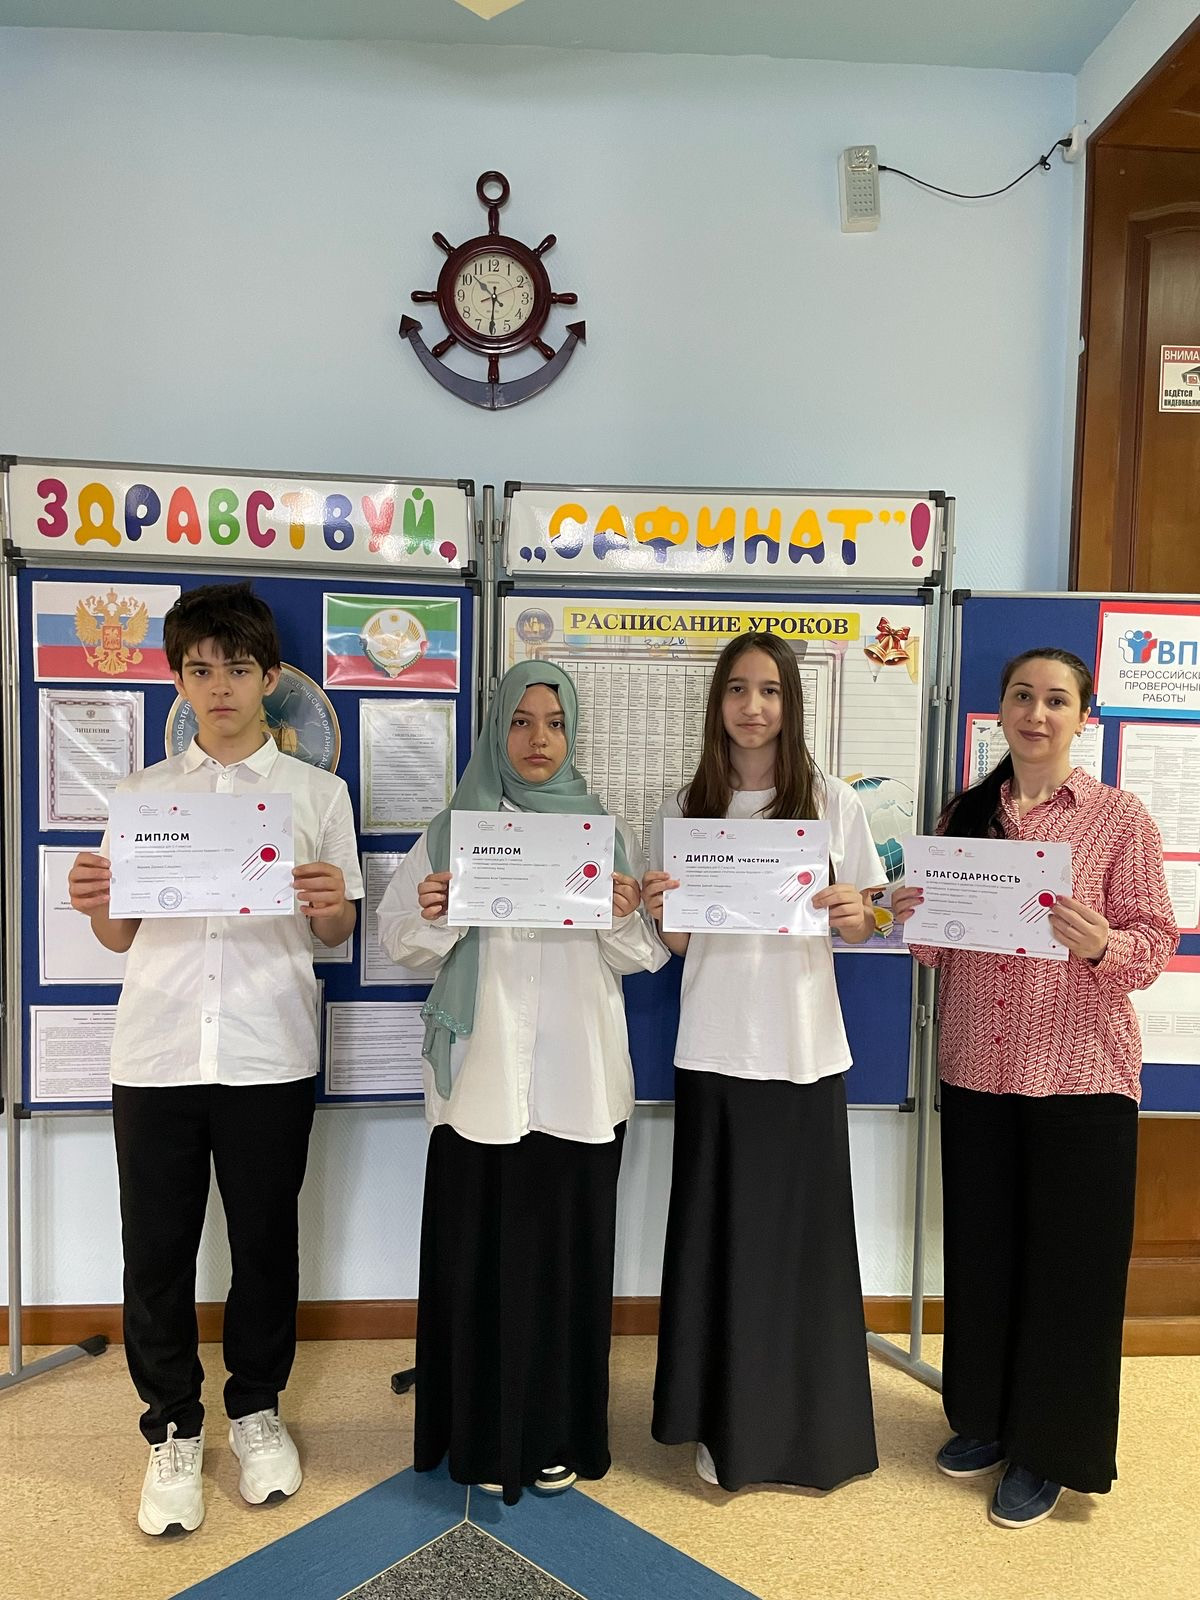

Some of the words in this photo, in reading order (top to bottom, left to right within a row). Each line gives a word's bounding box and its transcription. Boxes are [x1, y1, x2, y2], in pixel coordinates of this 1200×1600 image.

[474, 263, 483, 275] 11
[488, 259, 500, 272] 12
[507, 263, 511, 276] 1
[462, 273, 473, 286] 10
[516, 275, 524, 288] 2
[457, 289, 465, 302] 9
[521, 292, 529, 305] 3
[462, 306, 471, 319] 8
[514, 308, 523, 320] 4
[475, 318, 482, 331] 7
[503, 320, 511, 332] 5
[1164, 350, 1200, 361] ВНИМА
[37, 478, 457, 563] ЗДРАВСТВУЙ,
[570, 613, 741, 633] РАСПИСАНИЕ
[748, 616, 849, 635] УРОКОВ
[1158, 640, 1198, 666] ВП
[1119, 669, 1200, 680] ВСЕРОССИЙСК
[1124, 681, 1200, 692] ПРОВЕРОЧНЫ
[1142, 693, 1186, 703] РАБОТЫ
[135, 833, 190, 842] ДИПЛОМ
[472, 846, 521, 855] ДИПЛОМ
[685, 854, 734, 863] ДИПЛОМ
[926, 869, 1021, 884] БЛАГОДАРНОСТЬ
